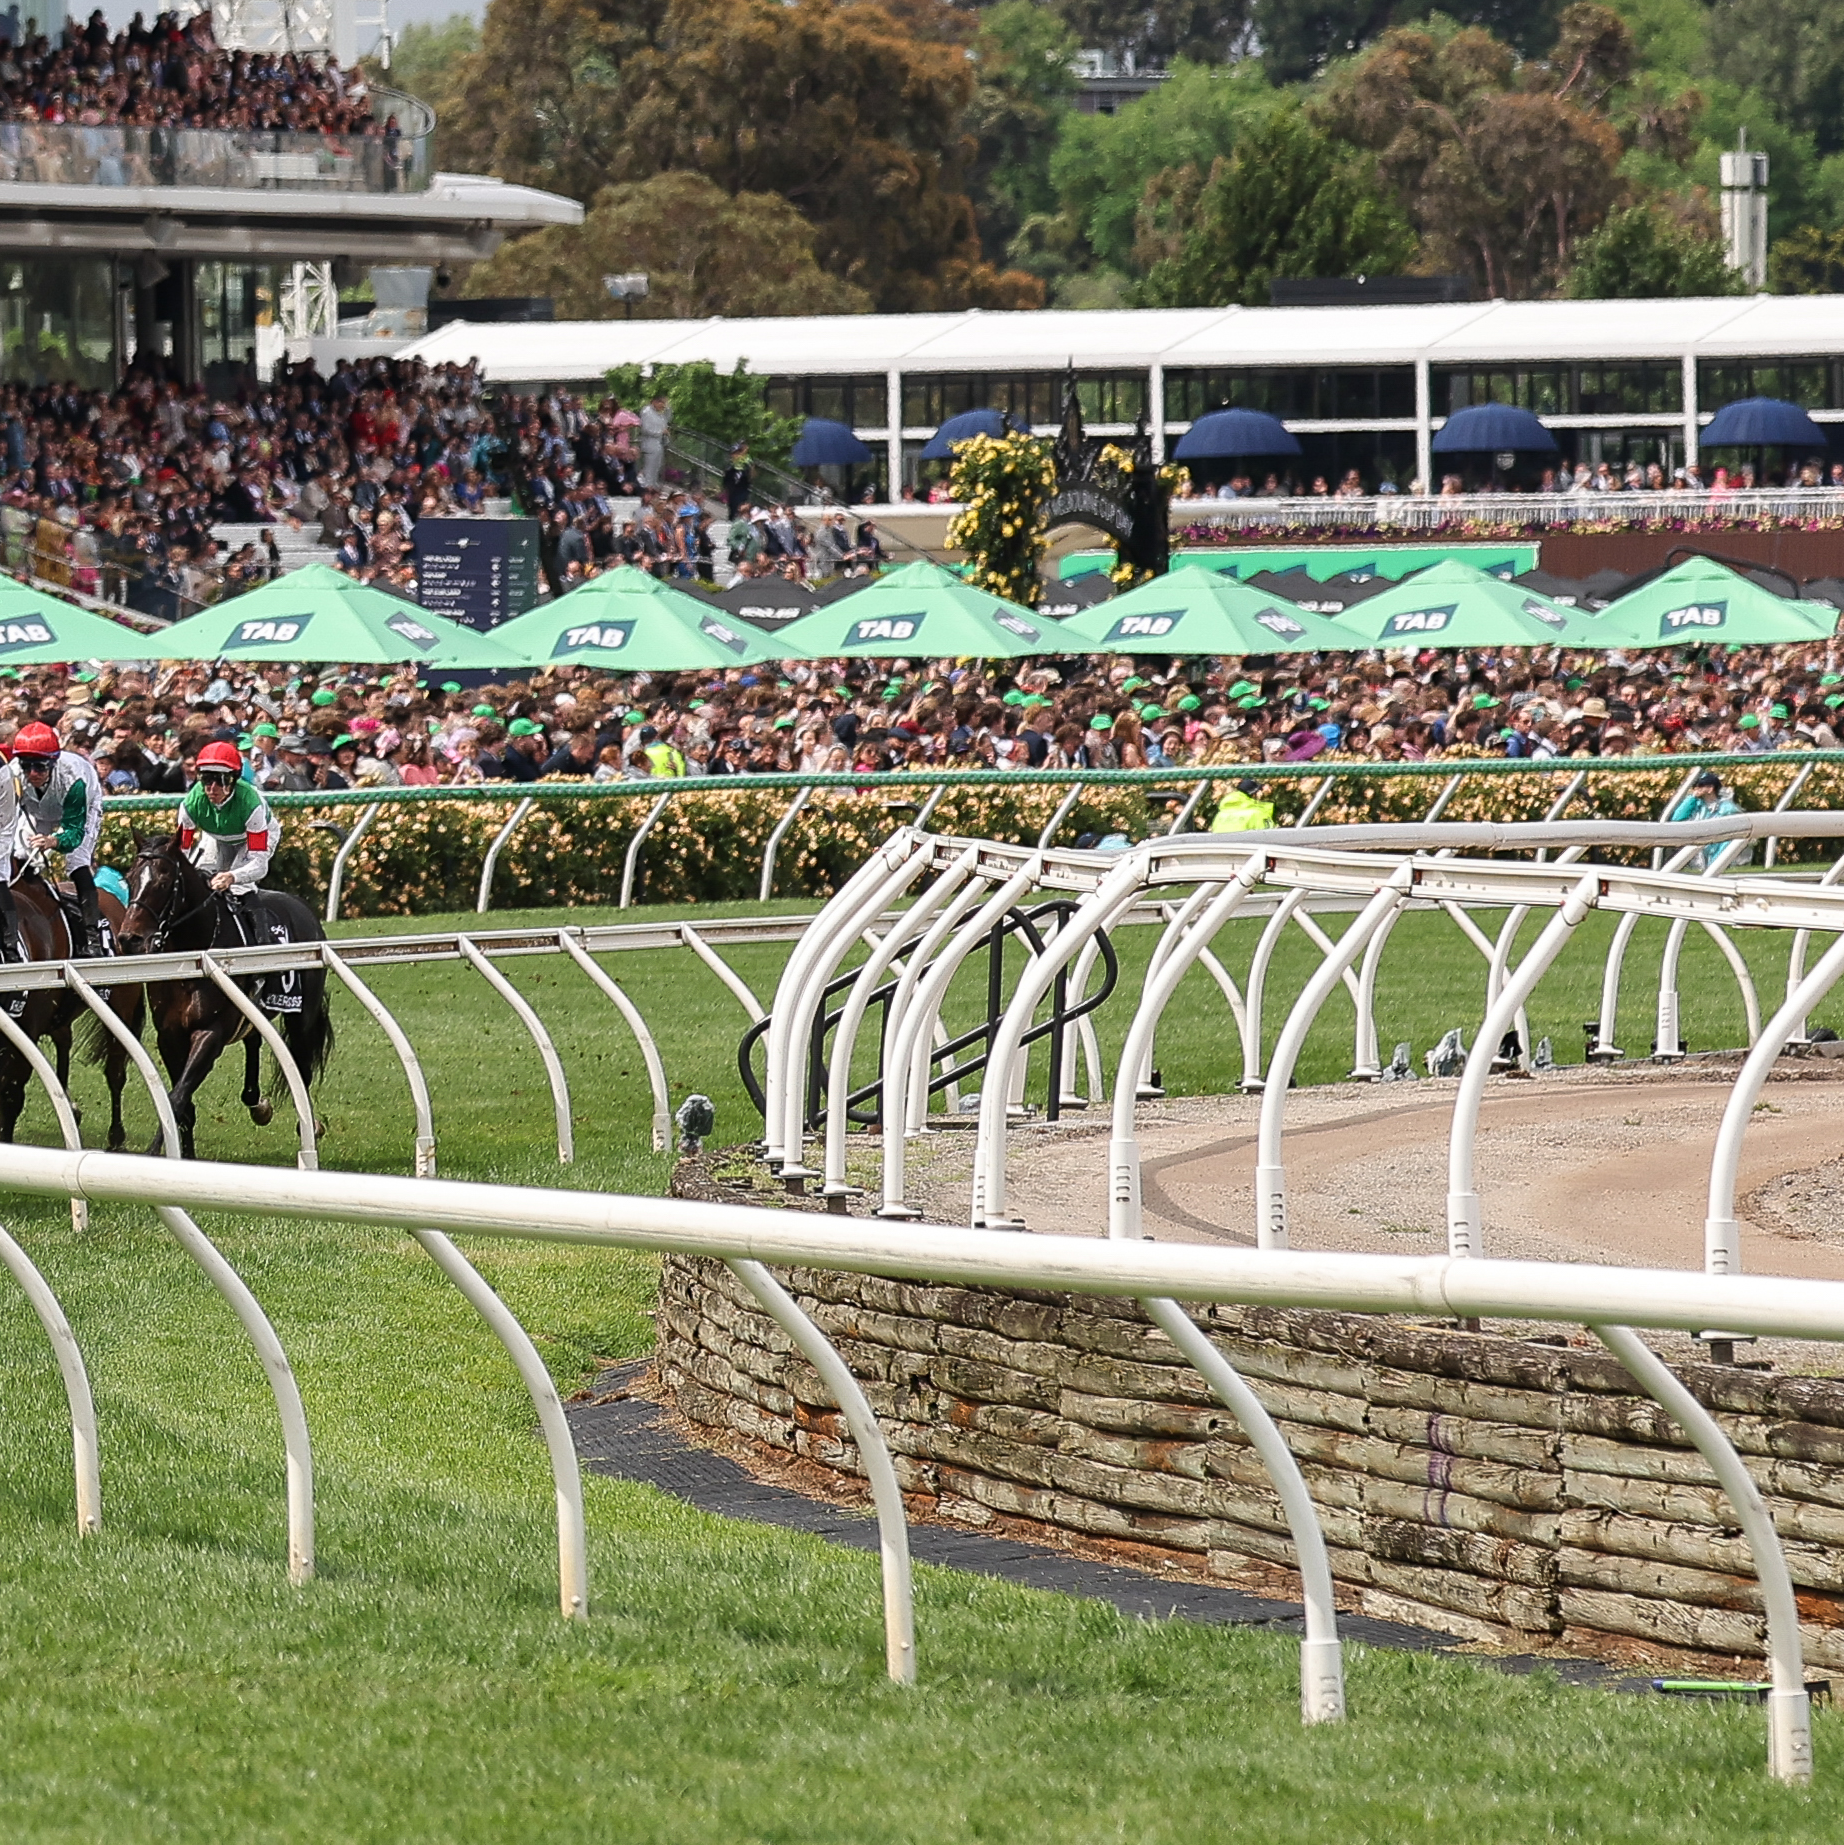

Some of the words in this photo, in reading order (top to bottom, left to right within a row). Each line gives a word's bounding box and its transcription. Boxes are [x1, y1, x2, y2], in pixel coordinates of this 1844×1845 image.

[1120, 616, 1173, 635] TAB
[1394, 612, 1447, 631] TAB
[1667, 606, 1720, 627] TAB
[241, 622, 299, 641] TAB
[566, 626, 625, 648] TAB
[858, 620, 914, 639] TAB
